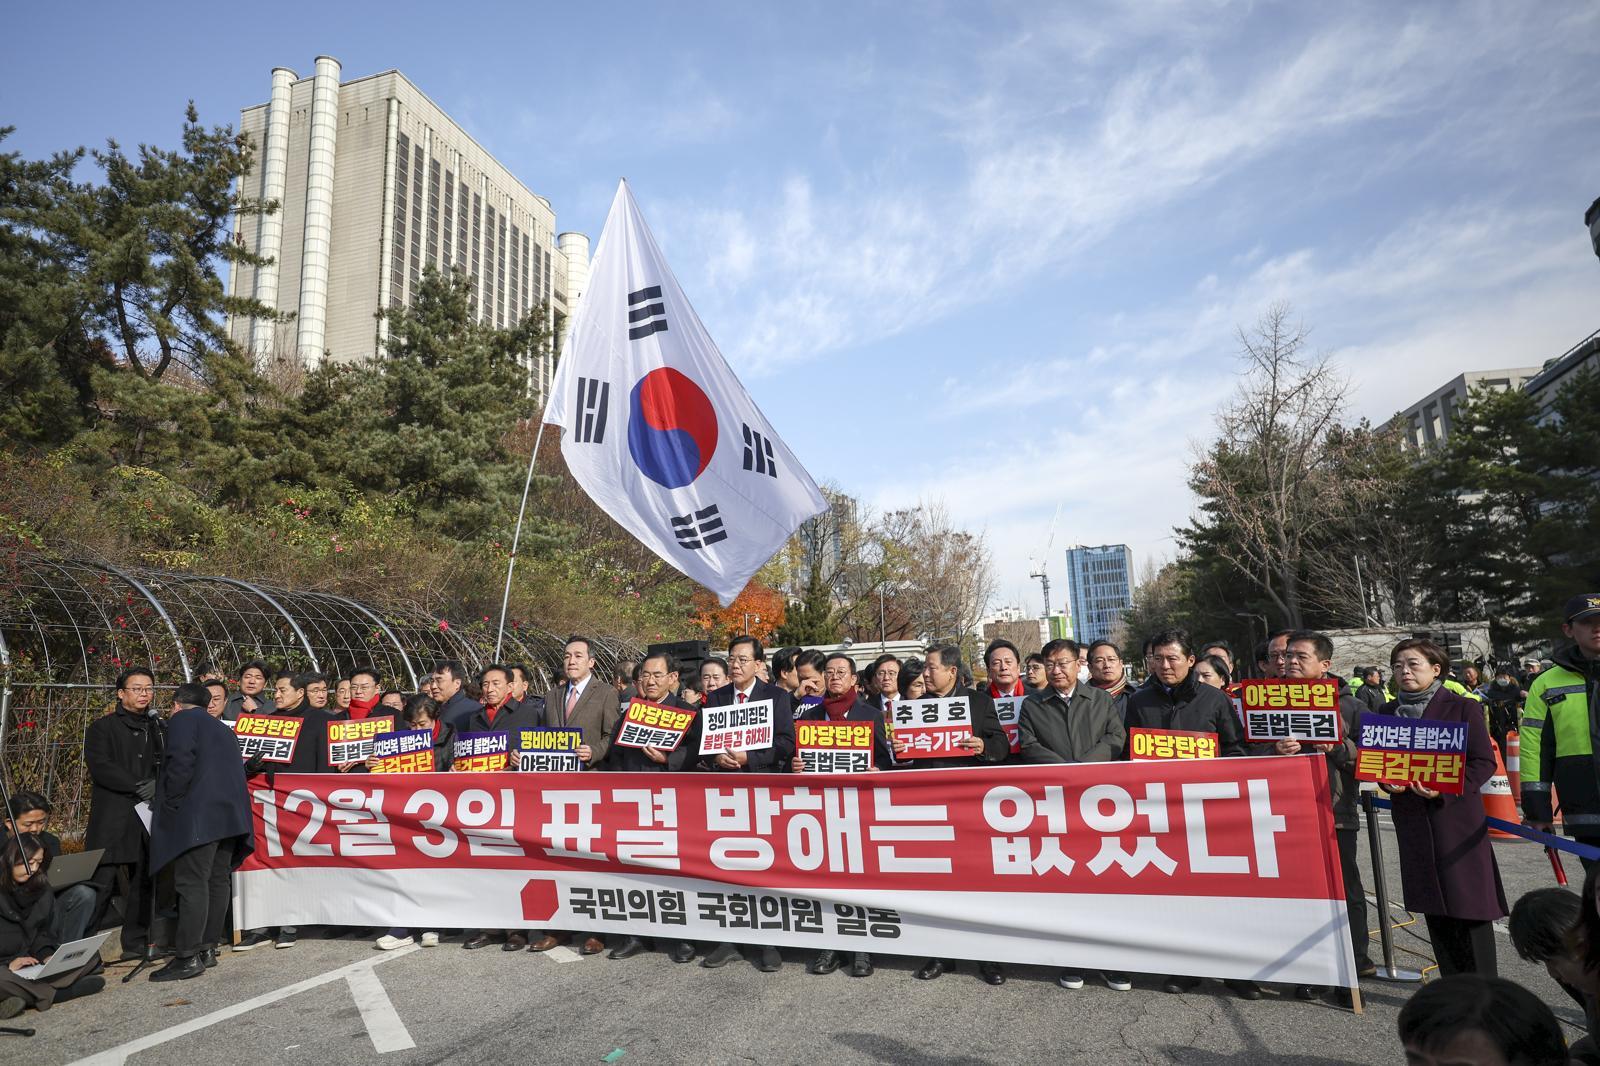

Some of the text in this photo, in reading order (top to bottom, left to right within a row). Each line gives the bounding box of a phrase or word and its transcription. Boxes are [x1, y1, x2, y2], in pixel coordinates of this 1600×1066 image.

[1246, 683, 1336, 708] 야당탄압
[236, 717, 300, 738] 야당탄압
[628, 702, 692, 730] 야당탄압
[708, 705, 768, 731] 정의 파괴집단
[1248, 713, 1335, 738] 불법특검
[329, 720, 392, 741] 야당탄압
[399, 732, 432, 753] 불법수사
[520, 731, 582, 751] 명비어천가
[621, 724, 680, 748] 불법특검
[703, 726, 771, 750] 불법특검 해체!
[799, 725, 872, 747] 야당탄압
[1361, 725, 1464, 750] 정치보복 불법수사
[474, 735, 507, 755] 불법수사
[1132, 733, 1216, 759] 야당탄압
[800, 752, 869, 772] 불법특검
[1359, 750, 1462, 783] 특검규탄
[253, 779, 1287, 878] 12월 3일 표결 방해는 없었다
[569, 886, 902, 939] 국민의힘 국회의원 일동
